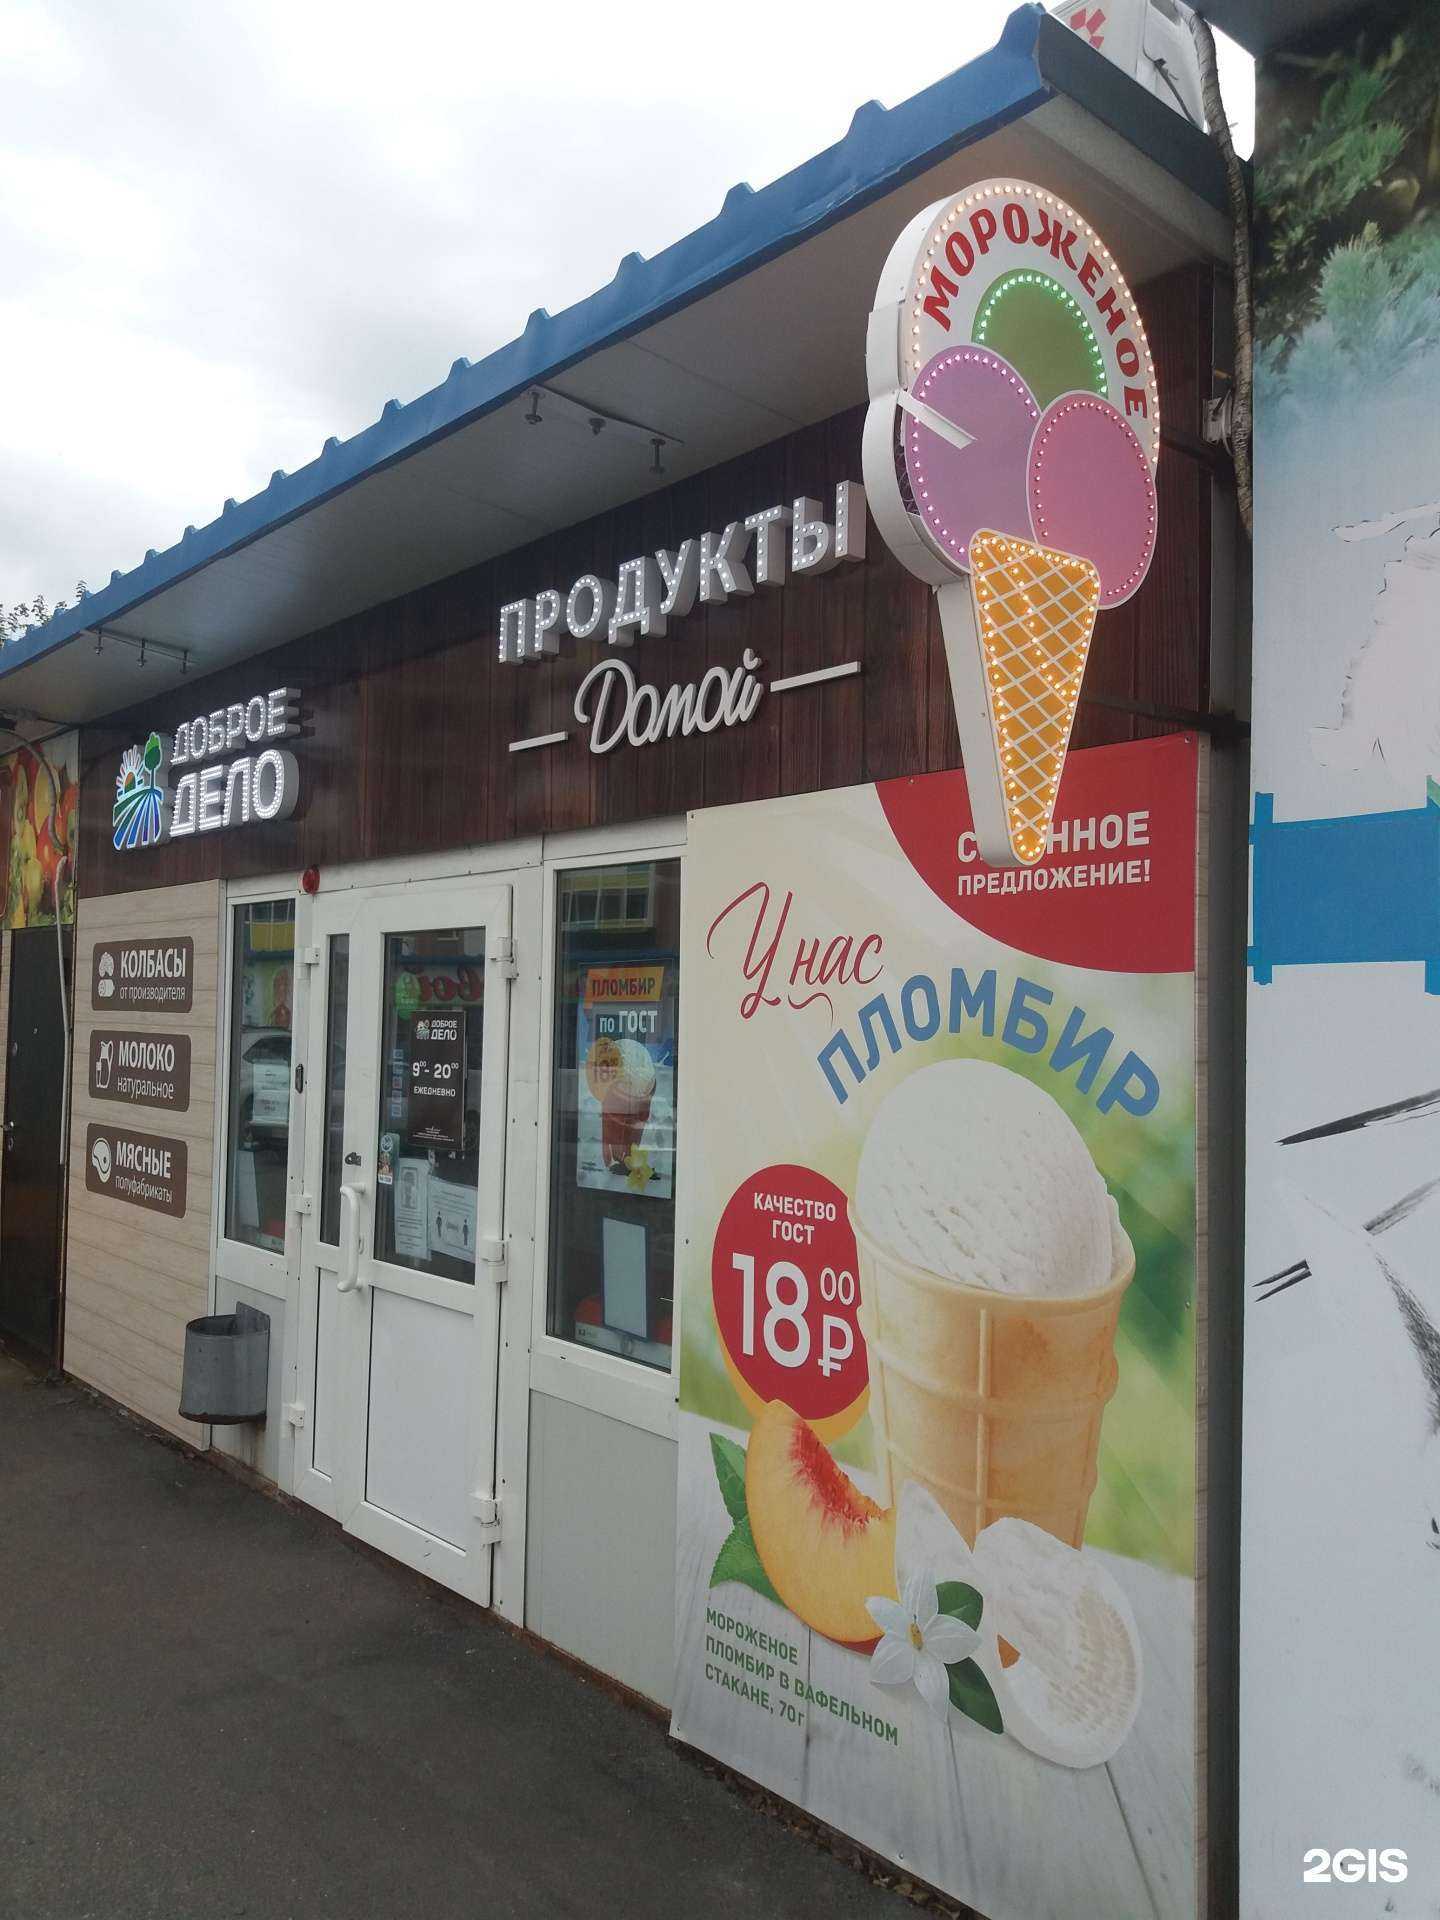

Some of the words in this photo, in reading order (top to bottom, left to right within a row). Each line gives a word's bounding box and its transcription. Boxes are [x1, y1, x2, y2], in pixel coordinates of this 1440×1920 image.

[923, 203, 1148, 418] МОРОЖЕНОЕ
[499, 480, 866, 664] ПРОДУКТЫ
[574, 648, 764, 754] Домой
[170, 687, 292, 765] ДОБРОЕ
[169, 749, 290, 837] ДЕЛО
[957, 810, 1151, 863] СННОЕ
[957, 859, 1151, 896] ПРЕДЛОЖЕНИЕ!
[120, 948, 187, 978] КОЛБАСЫ
[706, 881, 794, 1019] У
[789, 933, 885, 986] нас
[120, 987, 128, 999] от
[129, 986, 185, 1004] производителя
[592, 977, 655, 996] ПЛОМБИР
[430, 1029, 457, 1041] ДЕЛО
[431, 1019, 457, 1029] ДОБРОЕ
[619, 1010, 658, 1033] ГОСТ
[118, 1040, 175, 1072] МОЛОКО
[816, 967, 1160, 1117] ПЛОМБИР
[117, 1076, 174, 1100] натуральное
[413, 1085, 456, 1098] ЕЖЕДНЕВНО
[115, 1140, 172, 1179] МЯСНЫЕ
[115, 1175, 173, 1204] полуфабрикаты
[753, 1192, 837, 1222] КАЧЕСТВО
[772, 1219, 815, 1245] ГОСТ
[705, 1606, 798, 1666] МОРОЖЕНОЕ
[705, 1663, 774, 1715] СТАКАНЕ,
[705, 1635, 775, 1681] ПЛОМБИР
[779, 1670, 790, 1690] В
[794, 1678, 899, 1746] ВАФЕЛЬНОМ
